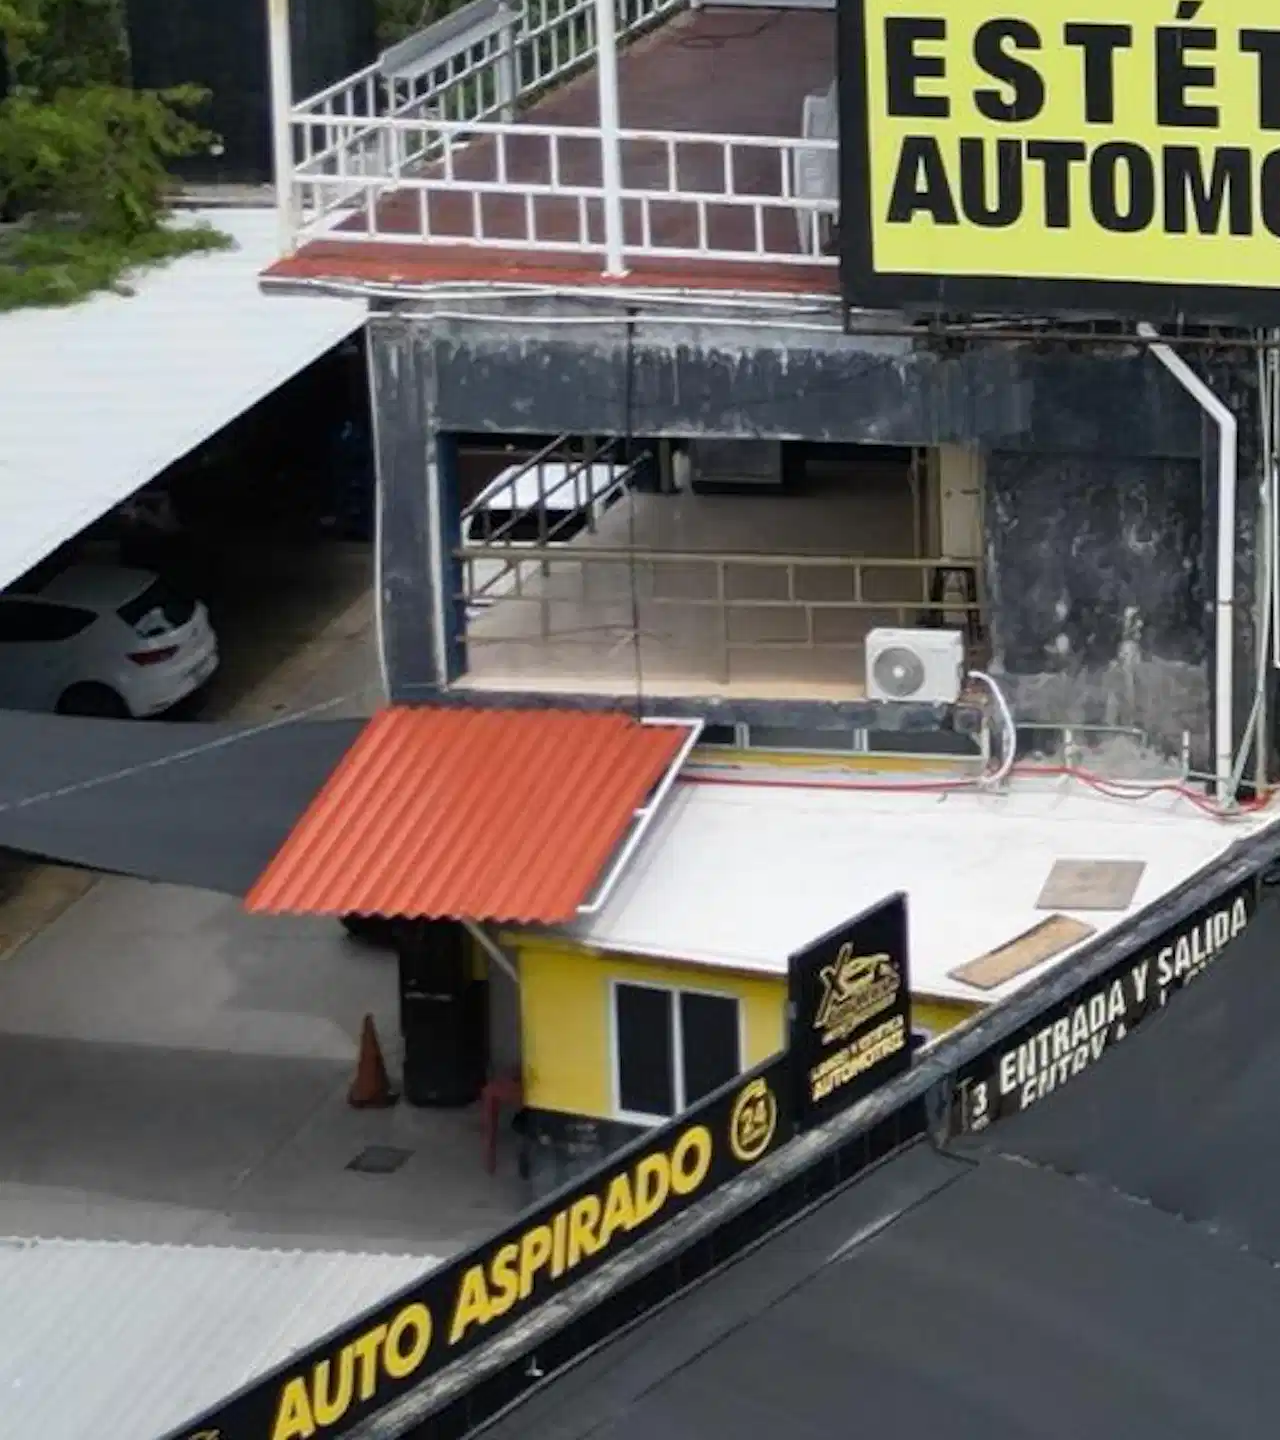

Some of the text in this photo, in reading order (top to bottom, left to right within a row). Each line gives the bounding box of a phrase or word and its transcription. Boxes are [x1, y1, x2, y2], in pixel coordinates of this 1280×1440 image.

[1000, 978, 1127, 1096] ENTRADA
[1132, 960, 1148, 1003] Y
[1157, 895, 1247, 986] SALIDA
[271, 1302, 434, 1440] AUTO
[448, 1125, 713, 1345] ASPIRADO
